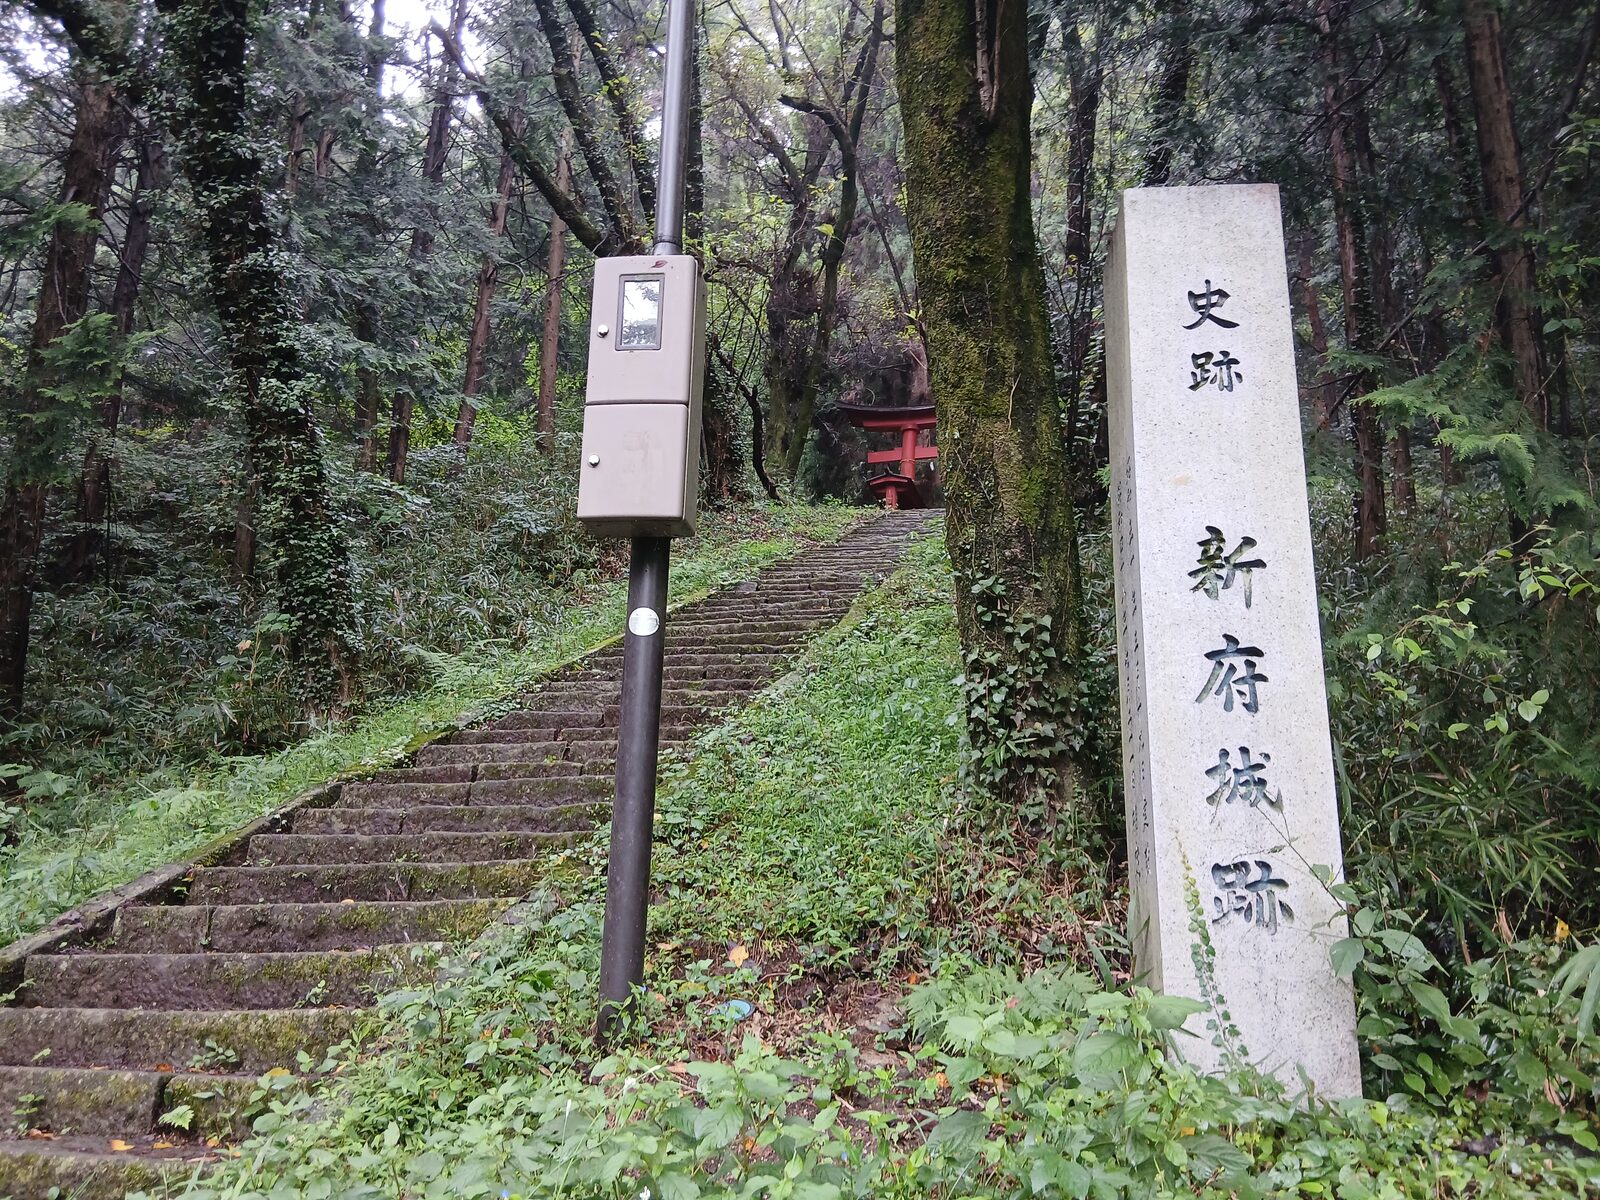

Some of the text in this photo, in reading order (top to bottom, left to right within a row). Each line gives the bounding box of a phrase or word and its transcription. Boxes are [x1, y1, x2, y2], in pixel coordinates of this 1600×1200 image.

[1182, 279, 1243, 392] 史跡
[1188, 525, 1294, 936] 新府城跡
